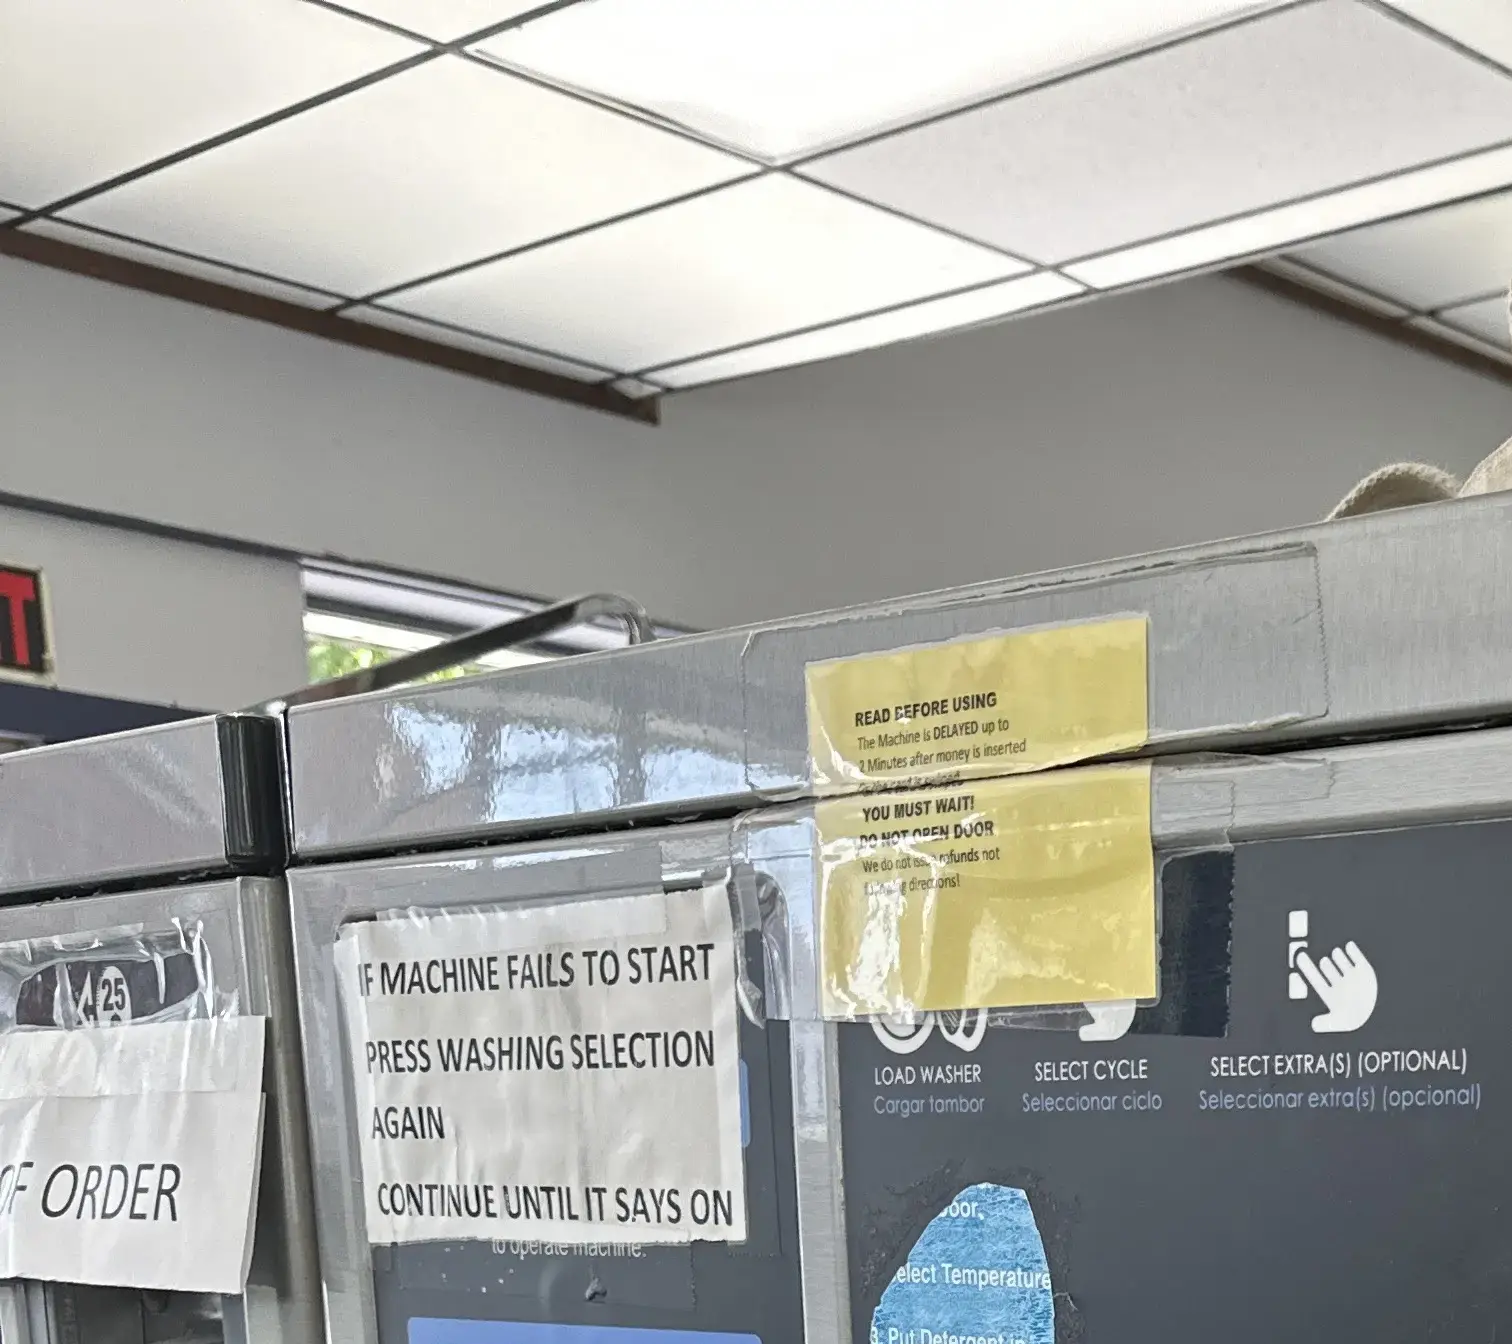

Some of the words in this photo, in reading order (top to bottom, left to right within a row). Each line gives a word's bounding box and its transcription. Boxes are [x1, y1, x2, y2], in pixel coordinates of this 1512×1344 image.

[0, 570, 36, 666] T
[854, 708, 891, 727] READ
[894, 700, 949, 722] BEFORE
[952, 692, 998, 713] USING
[862, 804, 890, 822] YOU
[894, 800, 932, 819] MUST
[935, 796, 975, 813] WAIT!
[359, 963, 374, 997] IF
[381, 956, 499, 995] MACHINE
[507, 952, 574, 989] FAILS
[583, 950, 620, 986] TO
[628, 944, 715, 984] START
[366, 1039, 431, 1074] PRESS
[437, 1035, 564, 1072] WASHING
[571, 1030, 715, 1068] SELECTION
[1210, 1056, 1269, 1077] SELECT
[1274, 1053, 1352, 1079] EXTRA(S)
[1358, 1050, 1468, 1076] (OPTIONAL)
[874, 1066, 916, 1085] LOAD
[920, 1064, 982, 1084] WASHER
[1034, 1061, 1088, 1081] SELECT
[1093, 1059, 1148, 1080] CYCLE
[372, 1106, 445, 1140] AGAIN
[41, 1162, 181, 1222] ORDER
[378, 1183, 494, 1218] CONTINUE
[503, 1185, 579, 1220] UNTIL
[587, 1186, 606, 1221] IT
[617, 1187, 681, 1223] SAYS
[690, 1189, 732, 1226] ON
